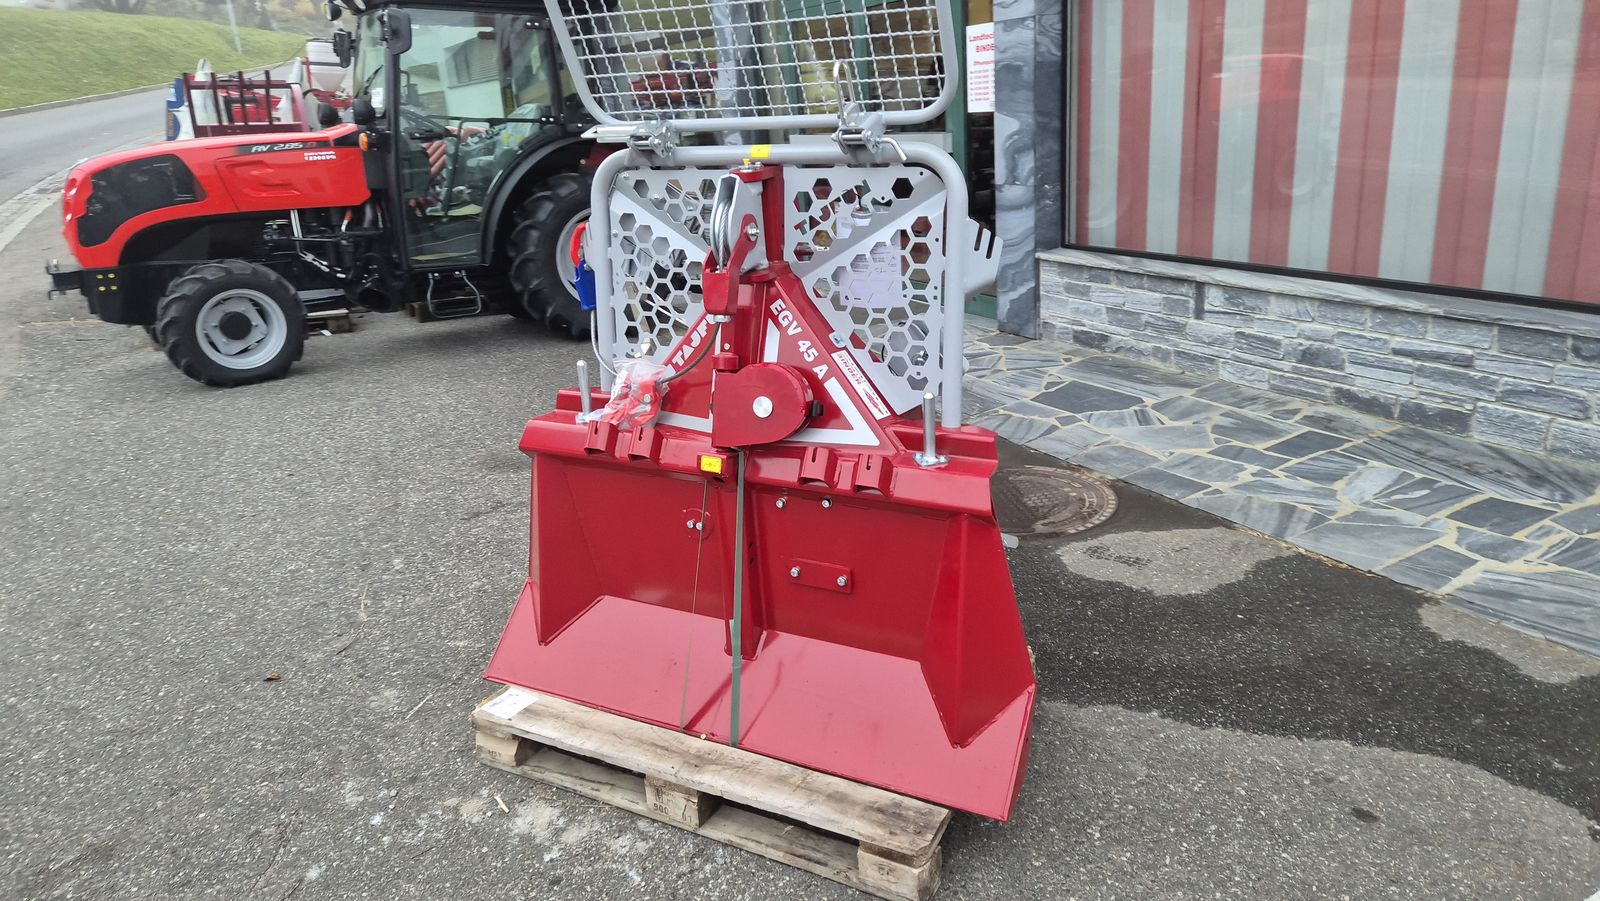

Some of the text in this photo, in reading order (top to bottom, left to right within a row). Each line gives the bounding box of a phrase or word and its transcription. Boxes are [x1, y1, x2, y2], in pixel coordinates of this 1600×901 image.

[769, 298, 829, 380] EGV 45 A
